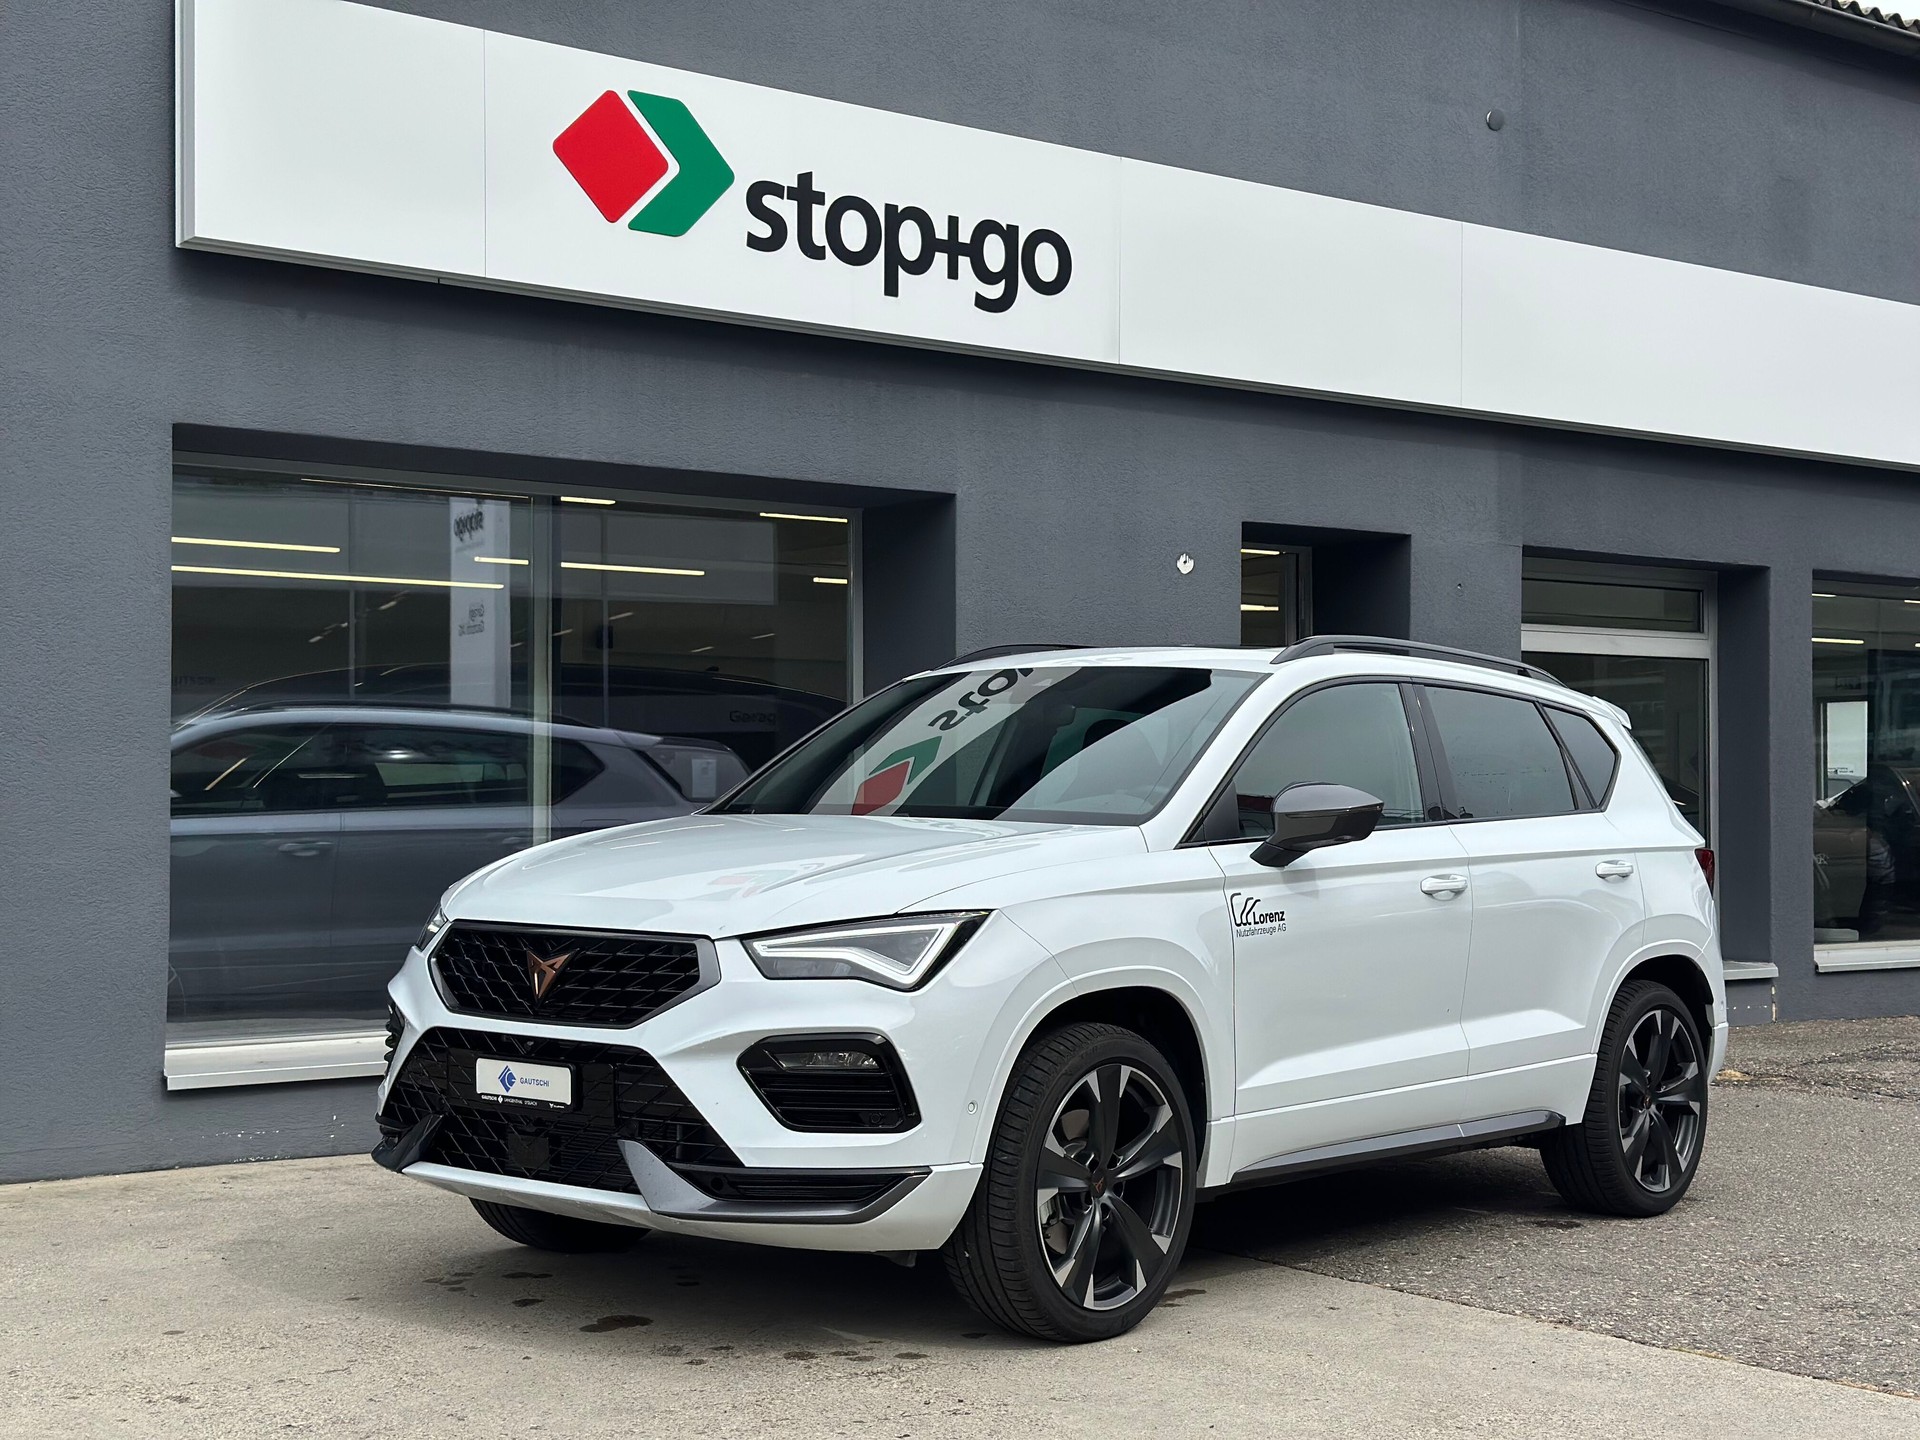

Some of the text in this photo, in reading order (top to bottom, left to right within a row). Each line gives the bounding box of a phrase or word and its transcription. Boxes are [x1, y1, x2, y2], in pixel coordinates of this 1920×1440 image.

[745, 171, 1072, 313] stop+go
[1253, 911, 1285, 924] Lorenz
[1236, 923, 1287, 937] Nutzfahrzeuge AG
[520, 1077, 549, 1087] GAUTSCHI
